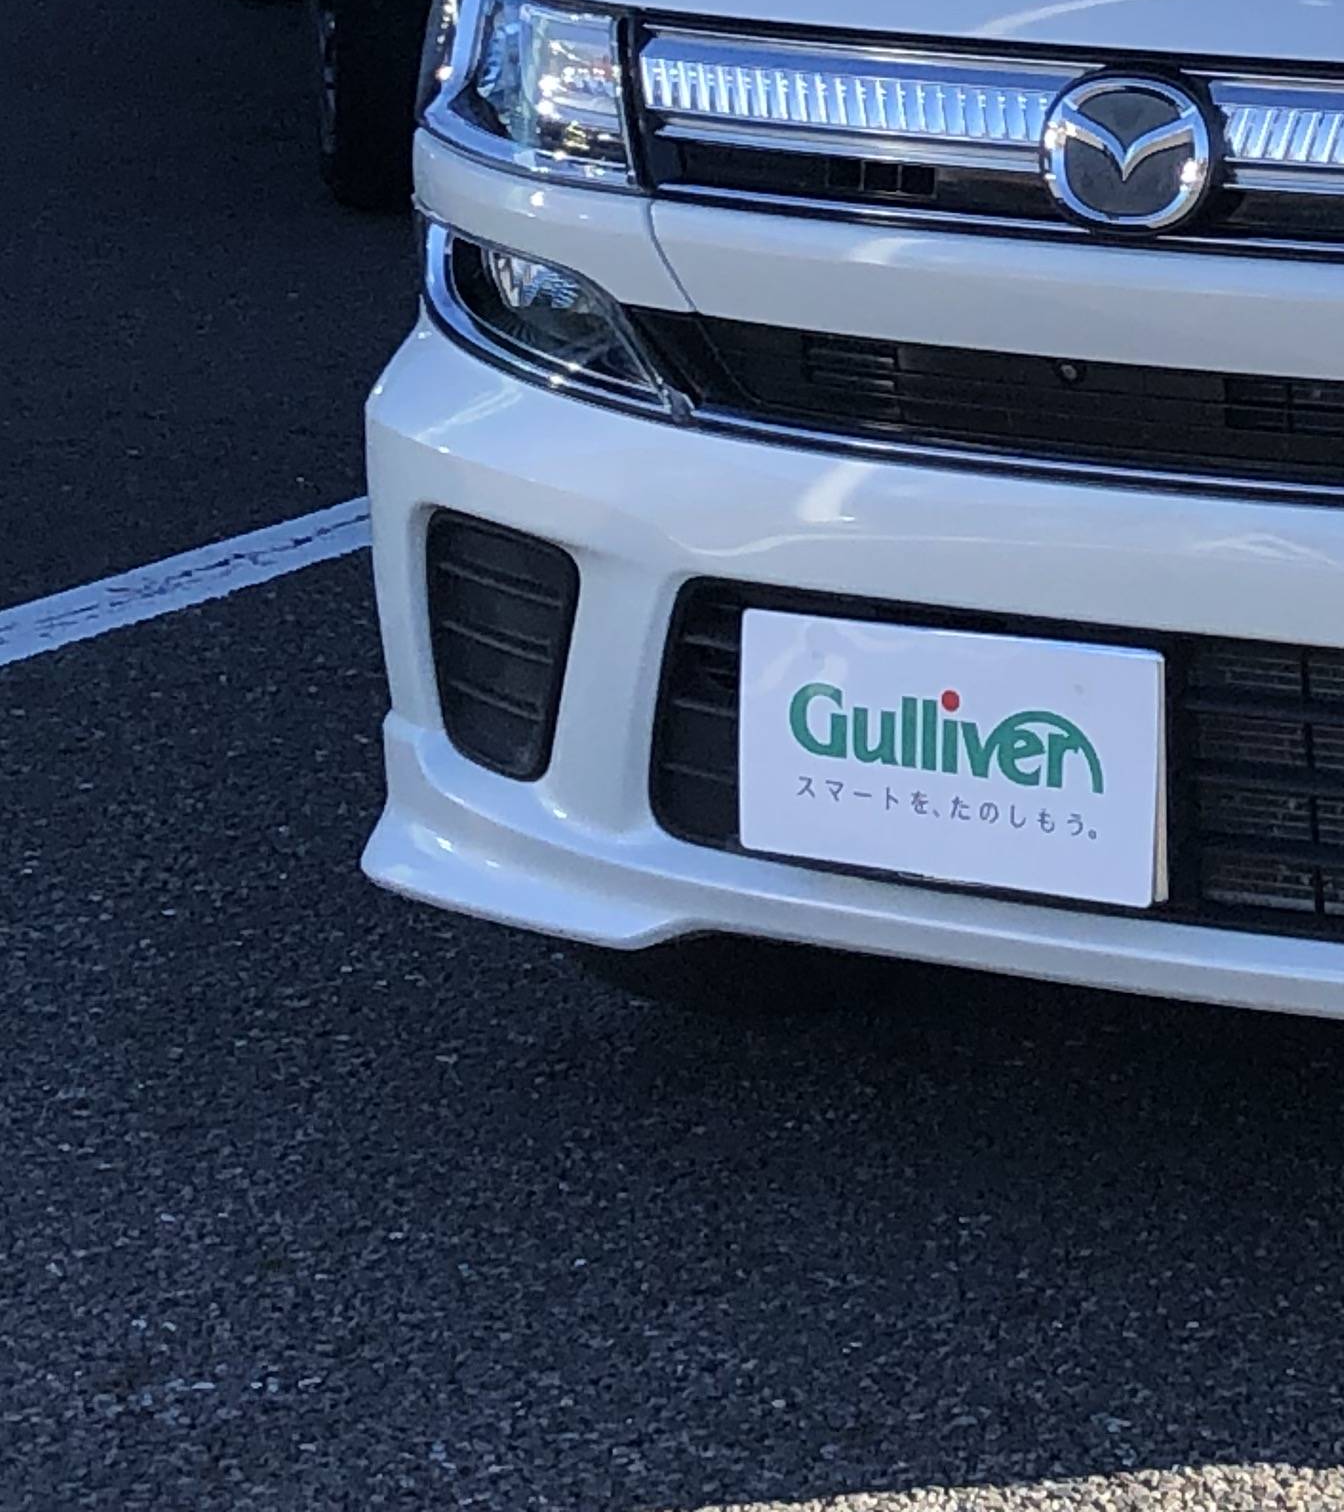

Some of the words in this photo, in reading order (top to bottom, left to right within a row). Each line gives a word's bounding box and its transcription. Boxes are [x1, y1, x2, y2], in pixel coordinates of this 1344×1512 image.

[789, 682, 1104, 795] Gulliver
[797, 776, 1097, 840] スマートを、たのしもう。
